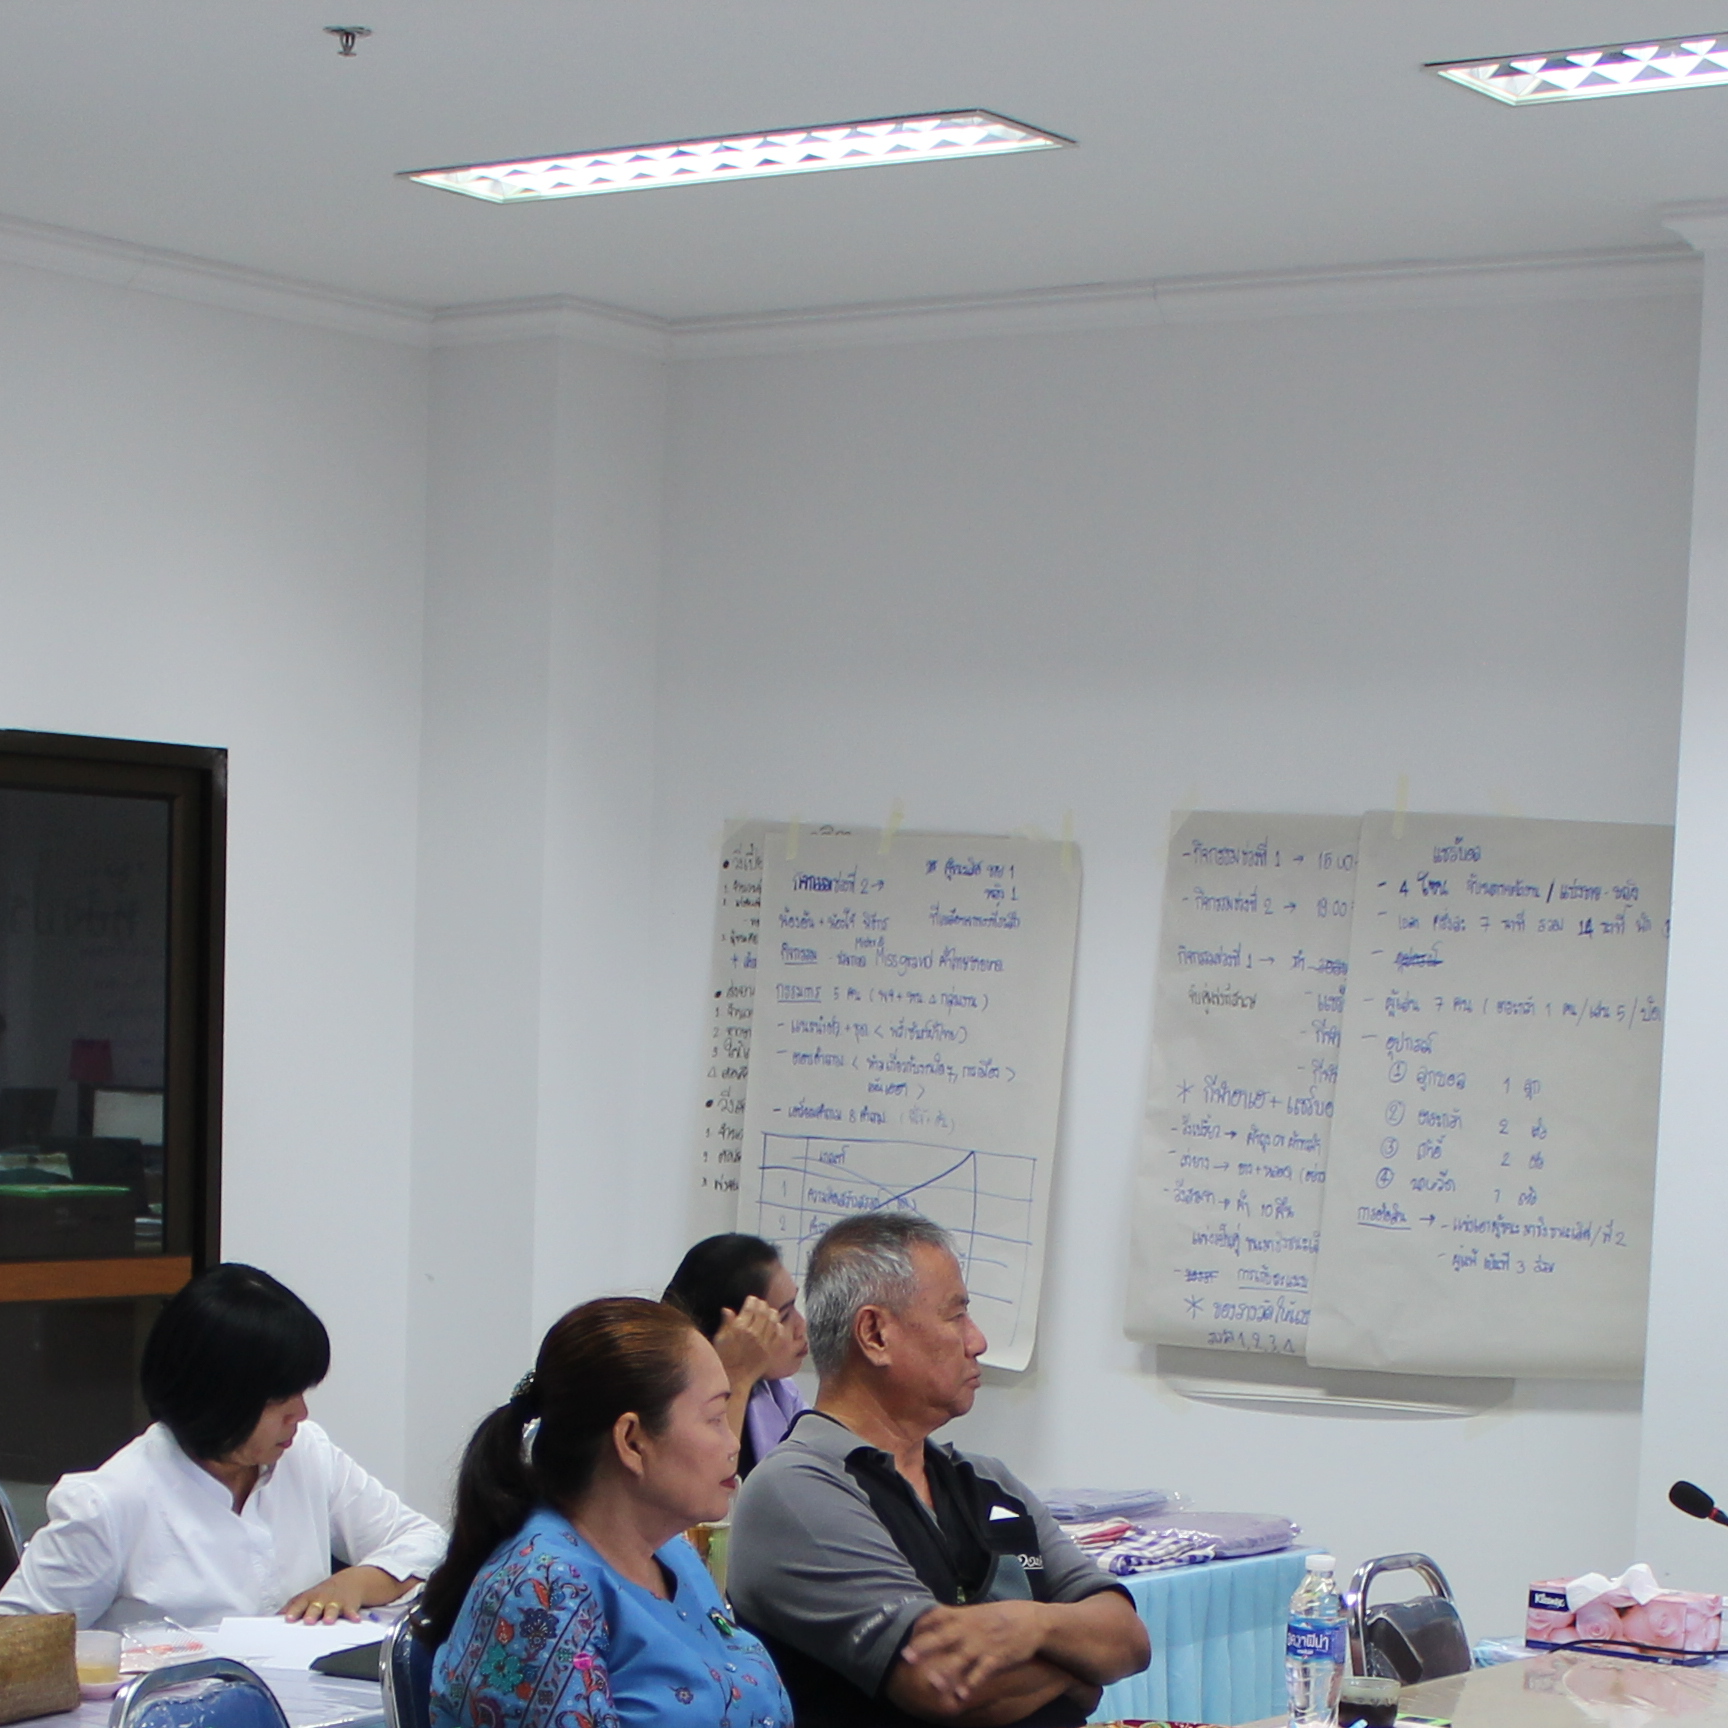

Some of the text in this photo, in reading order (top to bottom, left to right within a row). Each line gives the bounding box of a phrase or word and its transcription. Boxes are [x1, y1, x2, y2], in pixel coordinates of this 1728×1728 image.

[1263, 898, 1274, 915] 2
[1498, 1119, 1510, 1135] 2
[1500, 1152, 1511, 1167] 2
